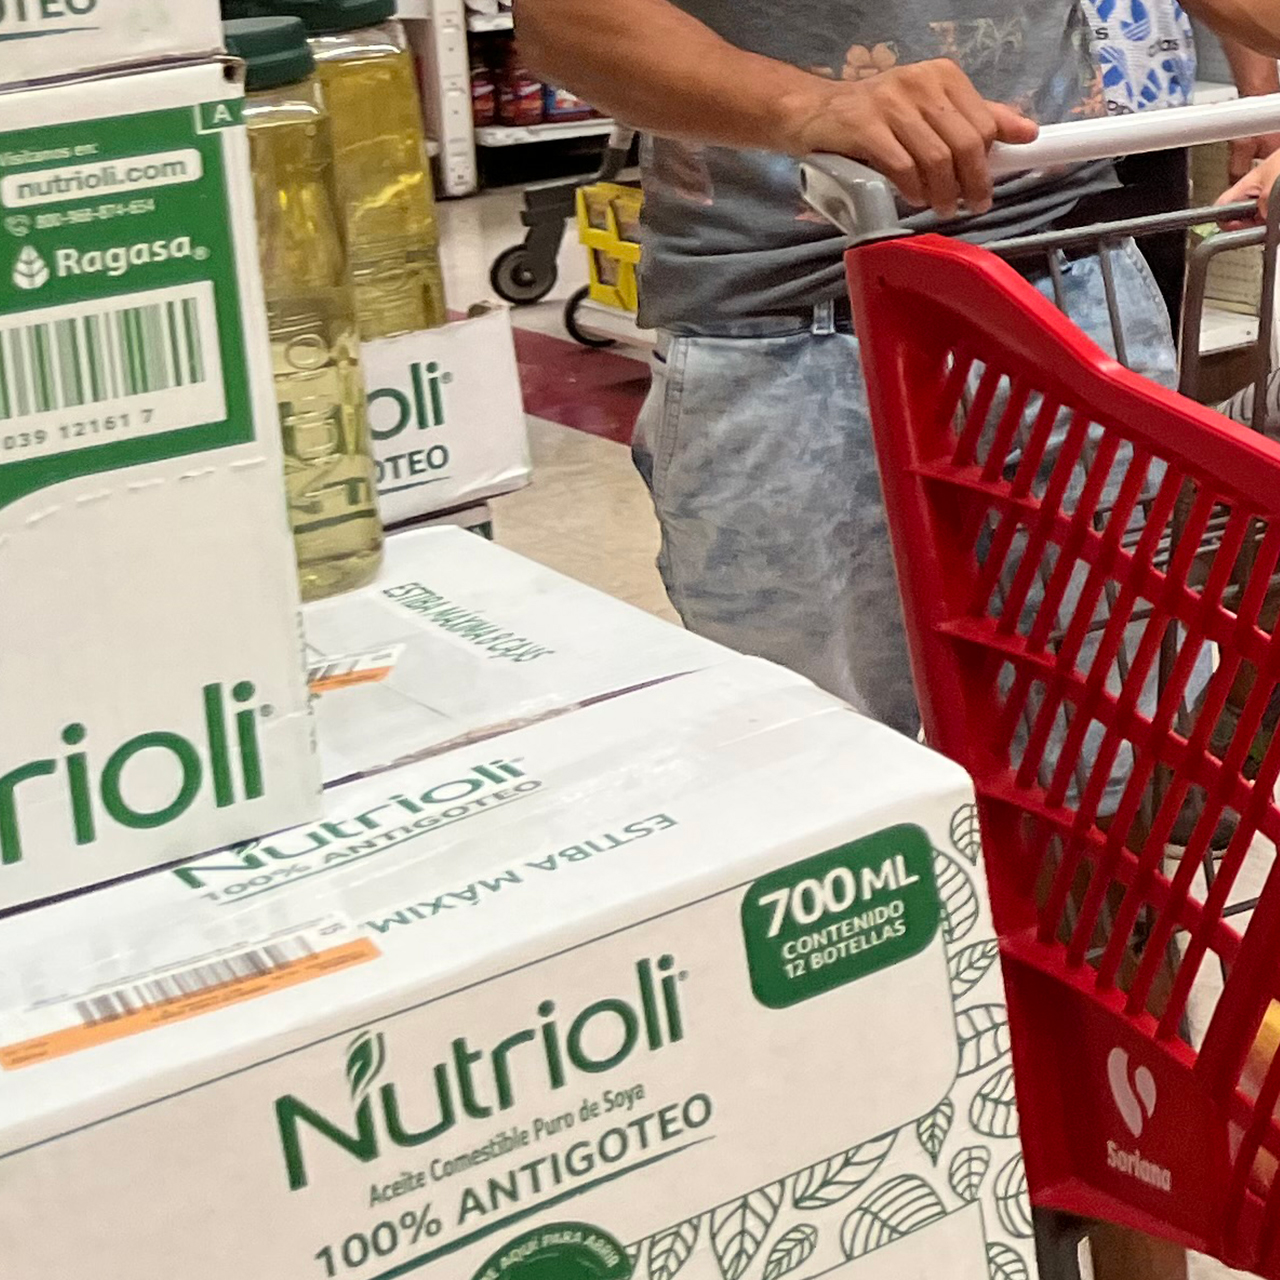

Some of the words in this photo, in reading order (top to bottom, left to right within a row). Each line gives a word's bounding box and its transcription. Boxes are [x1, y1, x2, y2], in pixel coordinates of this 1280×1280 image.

[212, 104, 233, 124] A
[17, 160, 188, 200] nutrioli.com
[55, 235, 192, 277] Ragasa
[172, 756, 532, 890] Nutrioli
[200, 863, 313, 902] 100%
[320, 779, 544, 862] ANTIGOTEO
[526, 812, 680, 872] ESTIBA
[758, 866, 857, 939] 700
[860, 854, 921, 901] ML
[781, 899, 906, 960] CONTENIDO
[783, 958, 807, 980] 12
[809, 919, 907, 971] BOTELLAS
[274, 953, 684, 1193] Nutrioli
[369, 1170, 427, 1208] Aceite
[430, 1127, 531, 1183] Comestible
[534, 1113, 577, 1142] Puro
[579, 1098, 601, 1124] de
[603, 1083, 646, 1115] Soya
[1106, 1138, 1172, 1193] Soriana
[314, 1202, 443, 1278] 100%
[456, 1091, 713, 1227] ANTIGOTEO
